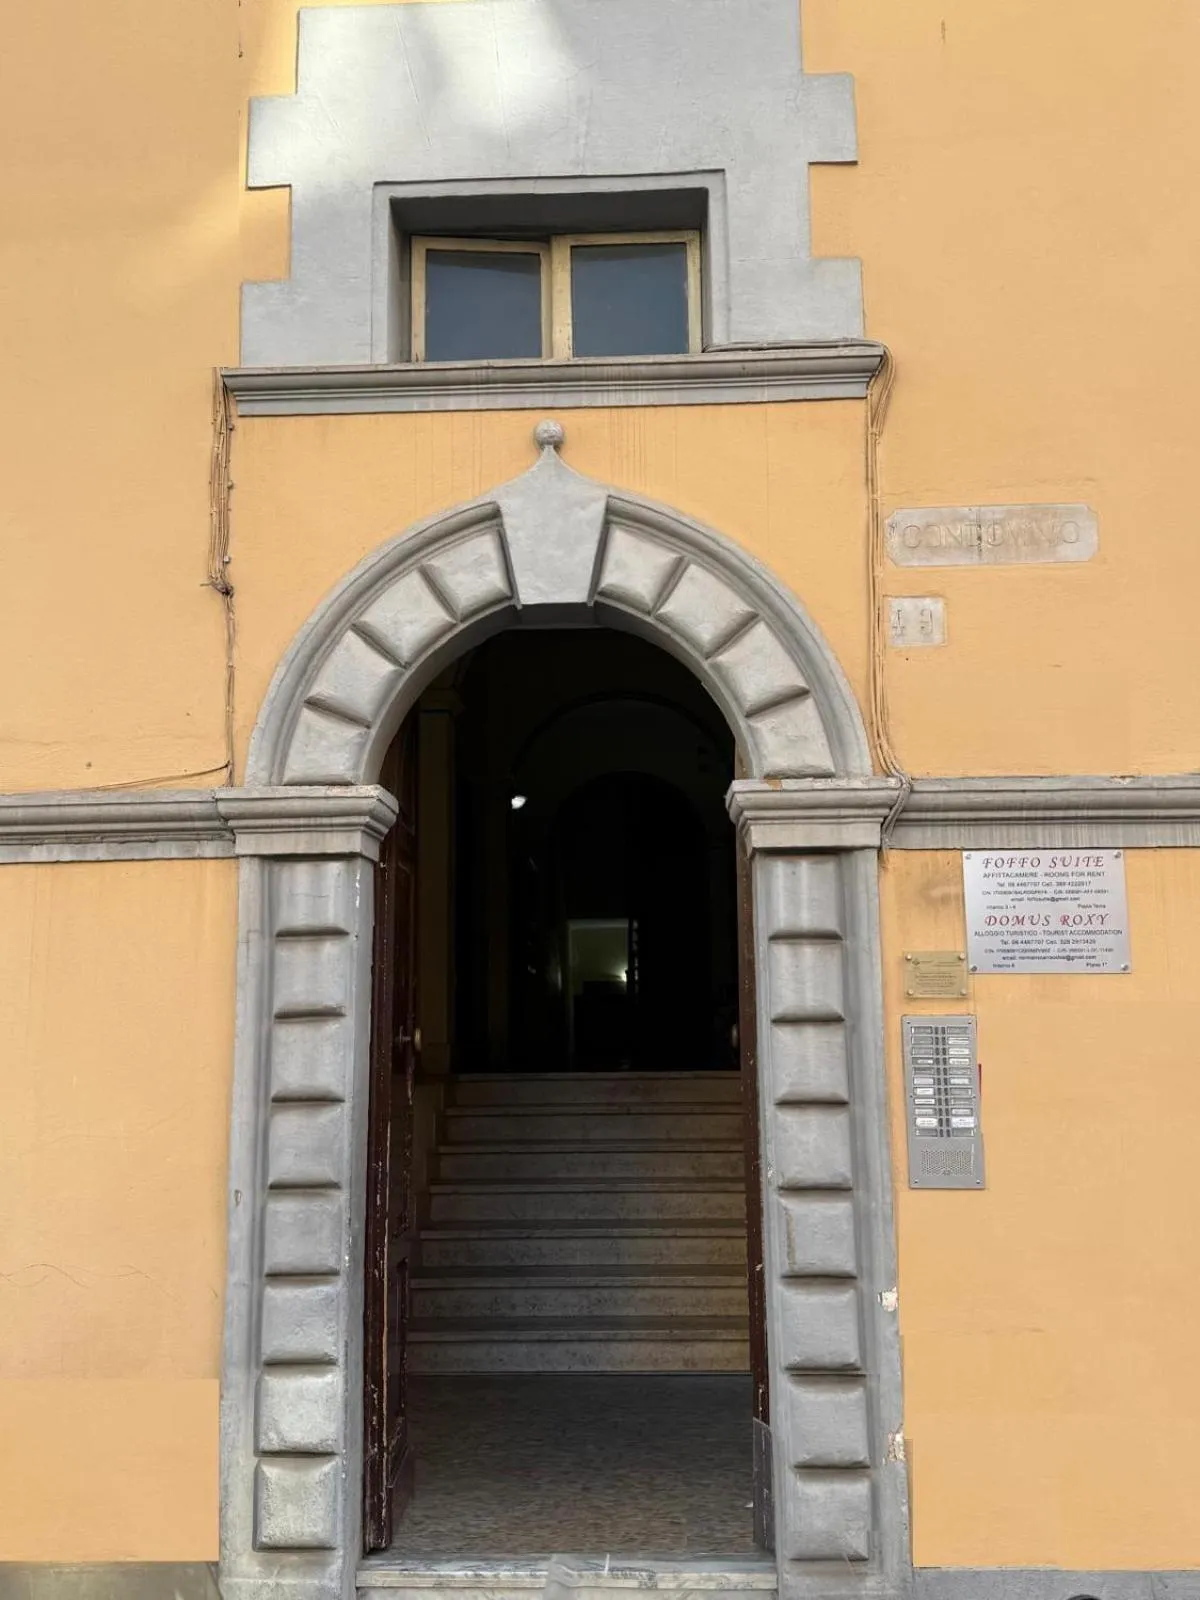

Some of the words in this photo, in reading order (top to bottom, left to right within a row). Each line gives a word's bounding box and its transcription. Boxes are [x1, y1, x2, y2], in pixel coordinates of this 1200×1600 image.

[982, 856, 1041, 869] FOFFO
[1049, 855, 1105, 868] SUITE
[984, 914, 1051, 927] DOMUS
[1060, 913, 1109, 927] ROXY
